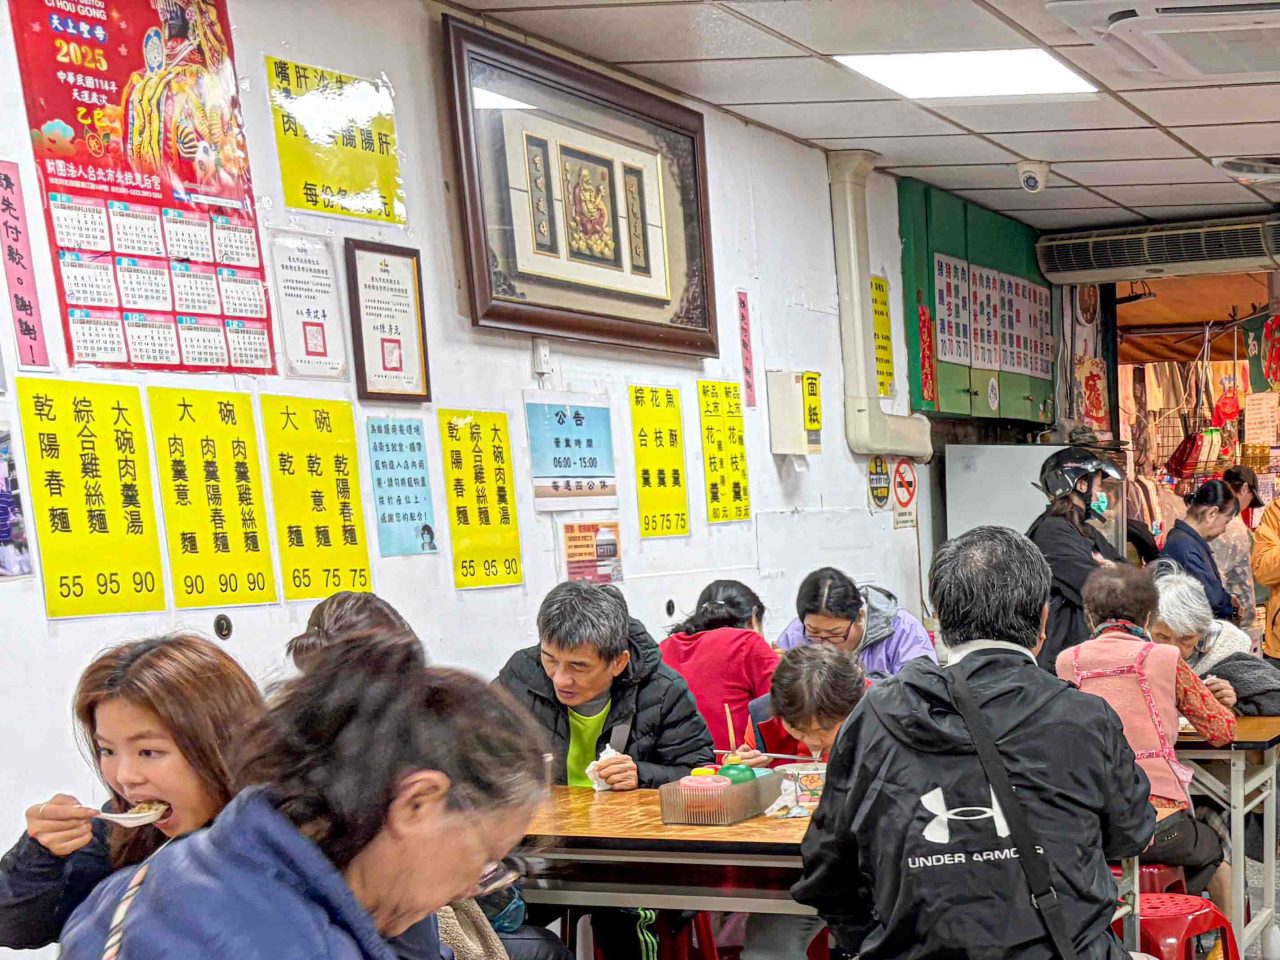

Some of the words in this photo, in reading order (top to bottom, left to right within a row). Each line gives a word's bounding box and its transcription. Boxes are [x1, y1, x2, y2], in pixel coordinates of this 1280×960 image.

[77, 4, 107, 21] GONG
[55, 39, 108, 71] 2025
[177, 397, 237, 426] 大碗
[280, 406, 332, 434] 大碗
[555, 410, 585, 427] 公告
[704, 401, 720, 414] 上市
[807, 376, 820, 425] 面紙
[33, 393, 72, 535] 乾陽春麵
[72, 396, 109, 535] 綜合雞絲麵
[111, 400, 144, 536] 大碗肉羹湯
[553, 457, 572, 468] 06:00
[579, 457, 597, 468] 15:00
[634, 386, 652, 488] 綜合羹
[650, 388, 667, 488] 花枝羹
[705, 425, 721, 504] 花枝羹
[728, 425, 743, 502] 花枝羹
[168, 434, 199, 555] 肉羹意麵
[201, 435, 230, 554] 肉羹陽春麵
[231, 437, 261, 553] 肉羹雞絲麵
[306, 453, 333, 549] 乾意麵
[333, 453, 358, 547] 乾陽春麵
[447, 420, 470, 526] 乾陽春麵
[491, 423, 510, 526] 大碗肉羹湯
[644, 515, 657, 532] 95
[660, 514, 672, 531] 75
[675, 513, 686, 530] 75
[59, 574, 84, 598] 55
[96, 572, 121, 595] 95
[132, 570, 155, 593] 90
[184, 574, 204, 594] 90
[219, 573, 238, 593] 90
[247, 571, 265, 591] 90
[292, 568, 311, 588] 65
[322, 568, 341, 588] 75
[349, 568, 367, 587] 75
[461, 559, 475, 577] 55
[483, 558, 498, 576] 95
[504, 557, 518, 575] 90
[908, 853, 966, 868] UNDER
